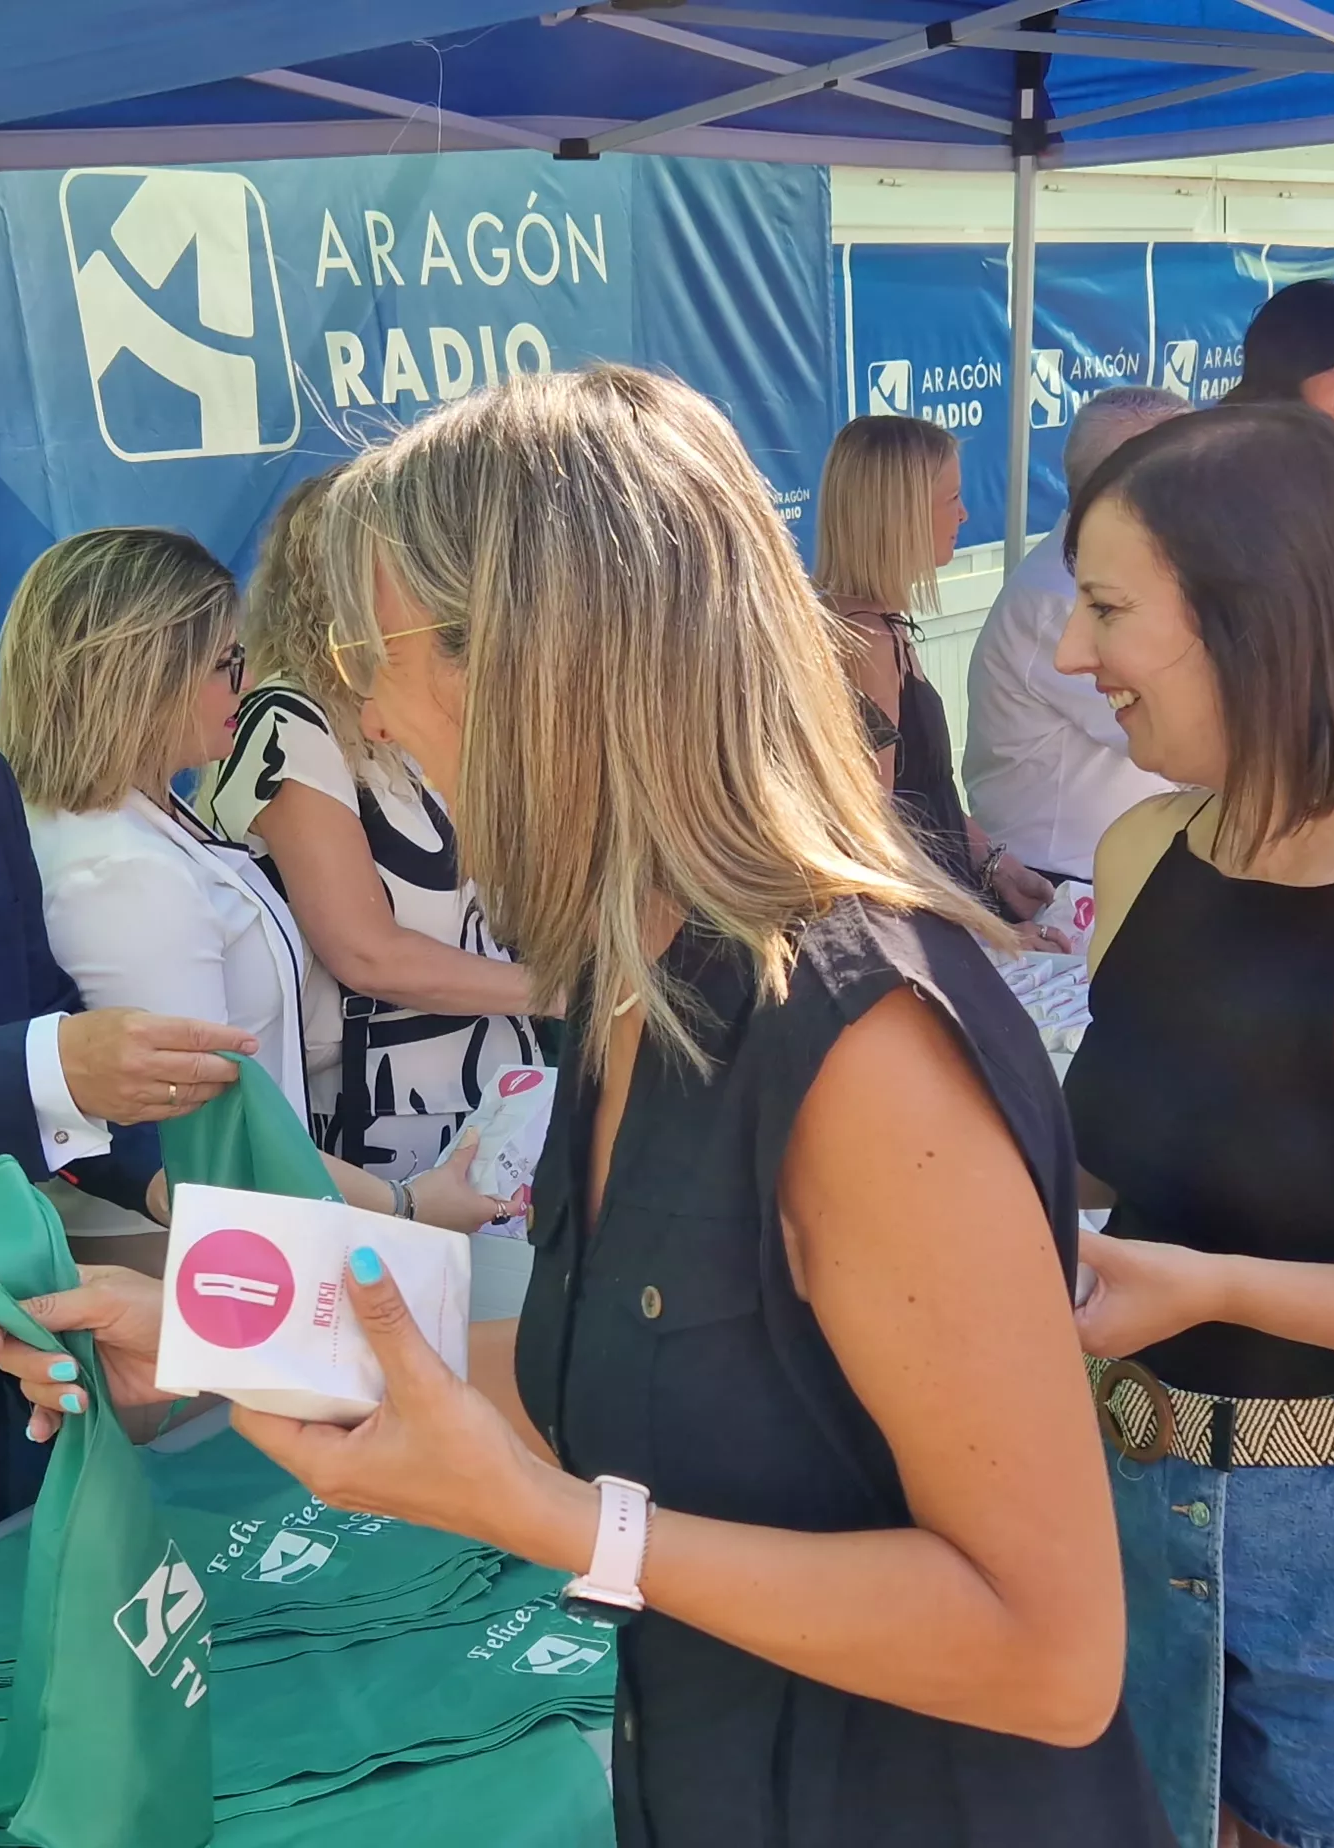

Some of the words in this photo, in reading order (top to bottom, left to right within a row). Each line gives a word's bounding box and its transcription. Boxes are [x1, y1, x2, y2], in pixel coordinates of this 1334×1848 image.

[316, 190, 608, 287] ARAGÓN
[325, 322, 551, 407] RADIO
[1070, 346, 1140, 380] ARAGÓN
[1203, 344, 1244, 369] ARAG
[921, 357, 1002, 394] ARAGÓN
[922, 400, 983, 429] RADIO
[779, 506, 802, 520] ADIO
[313, 1281, 337, 1328] ASCASO
[171, 1657, 207, 1708] TV
